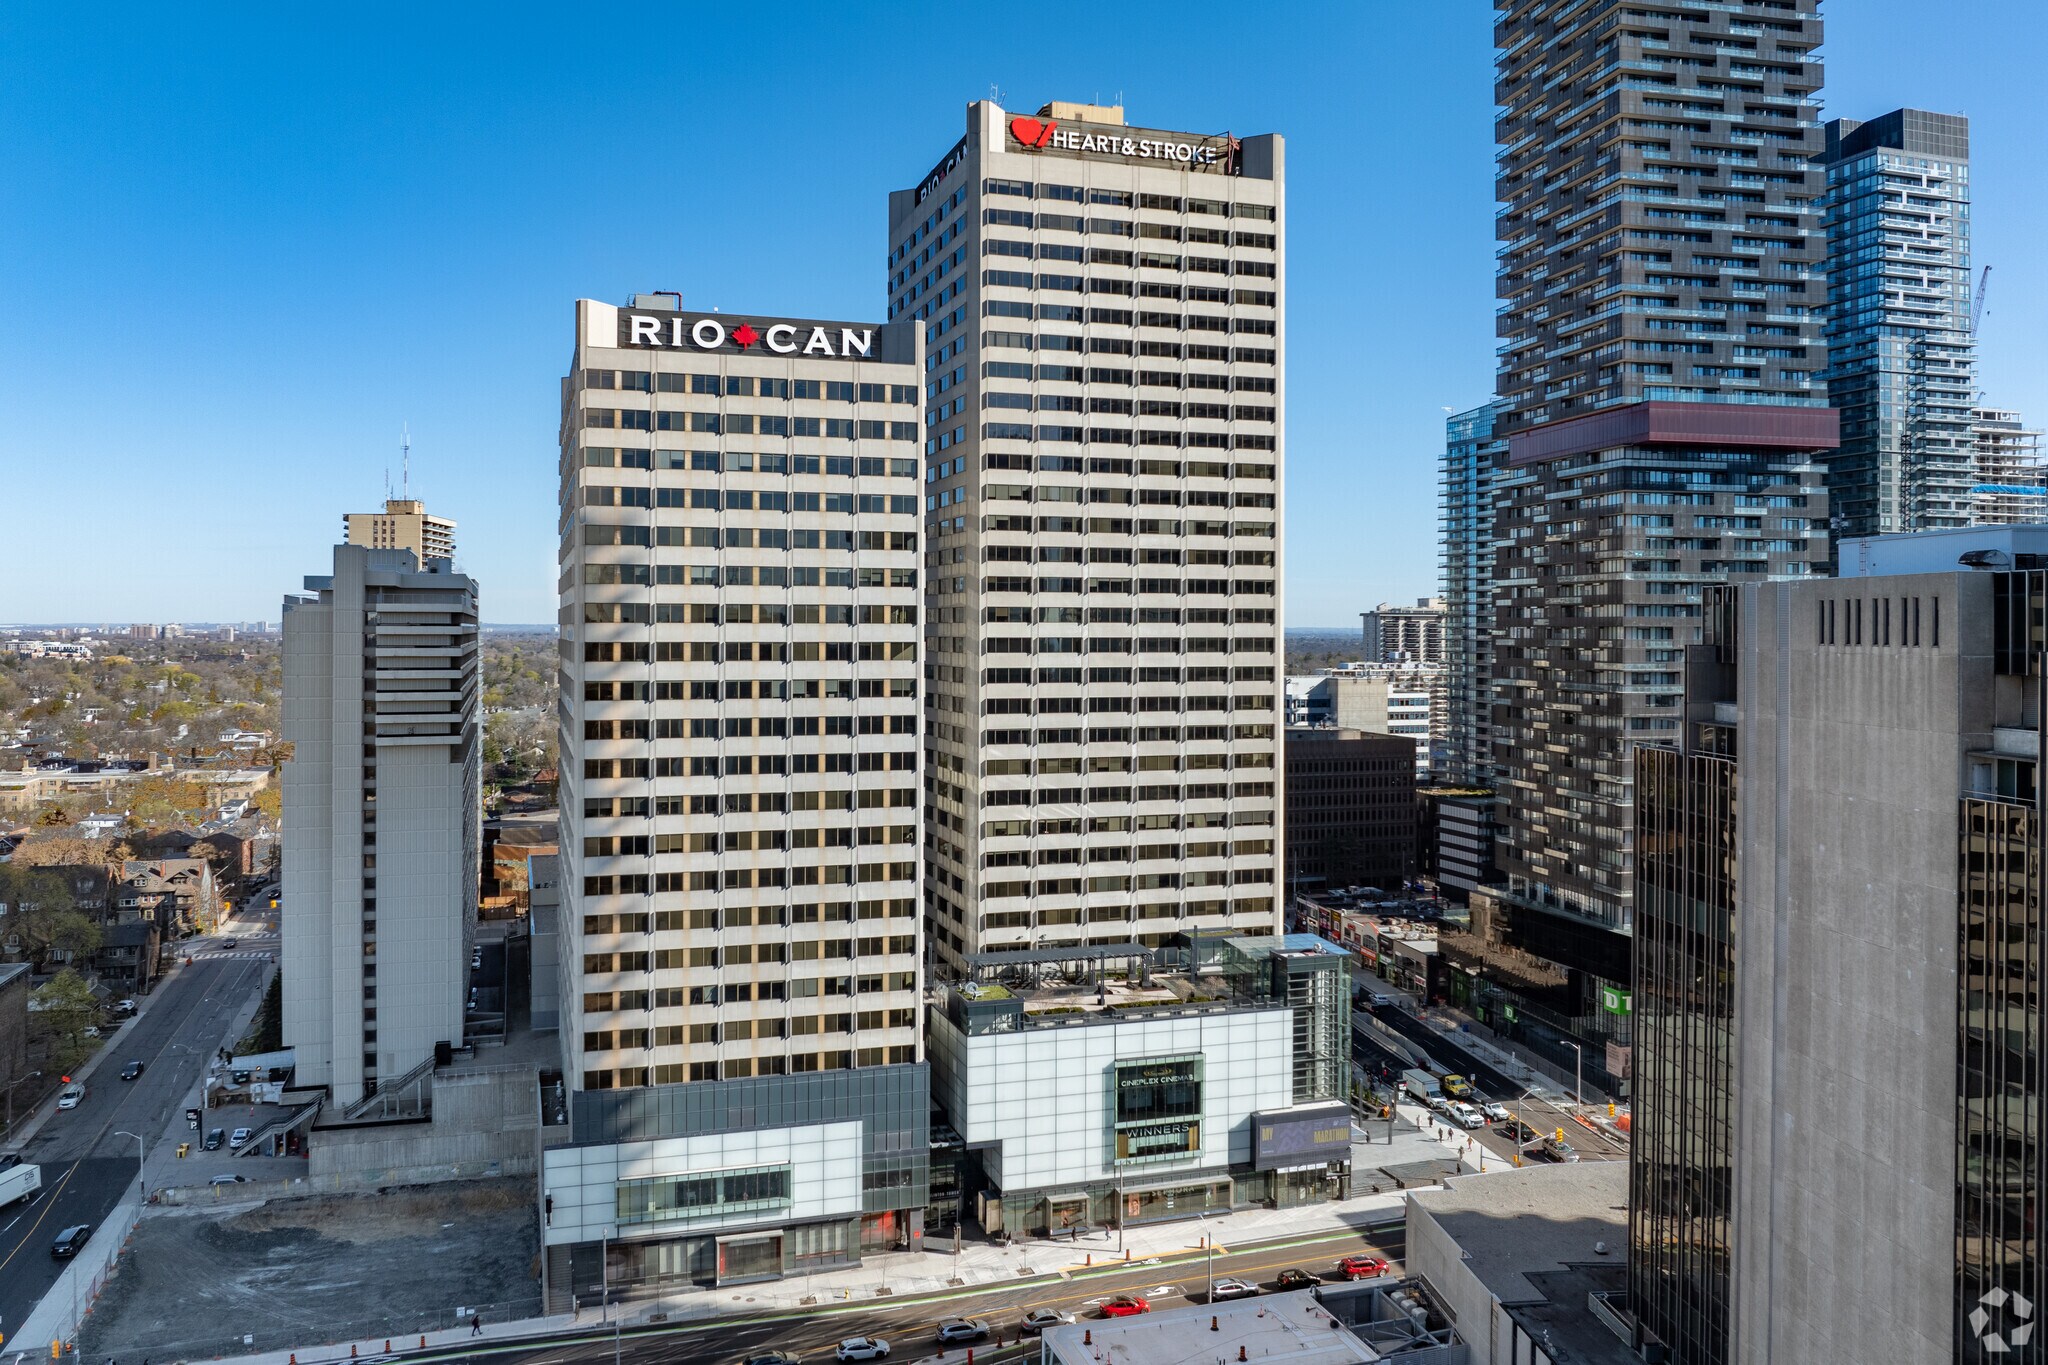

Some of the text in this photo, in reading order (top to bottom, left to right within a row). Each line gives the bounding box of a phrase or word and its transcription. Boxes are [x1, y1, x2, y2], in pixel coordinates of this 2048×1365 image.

[629, 315, 872, 358] RIO CAN
[1121, 1074, 1194, 1087] CINEPLEX CINEMAS
[1126, 1123, 1190, 1138] WINNERS
[1313, 1127, 1349, 1144] MARATHON
[1152, 1186, 1195, 1197] SEPHORA
